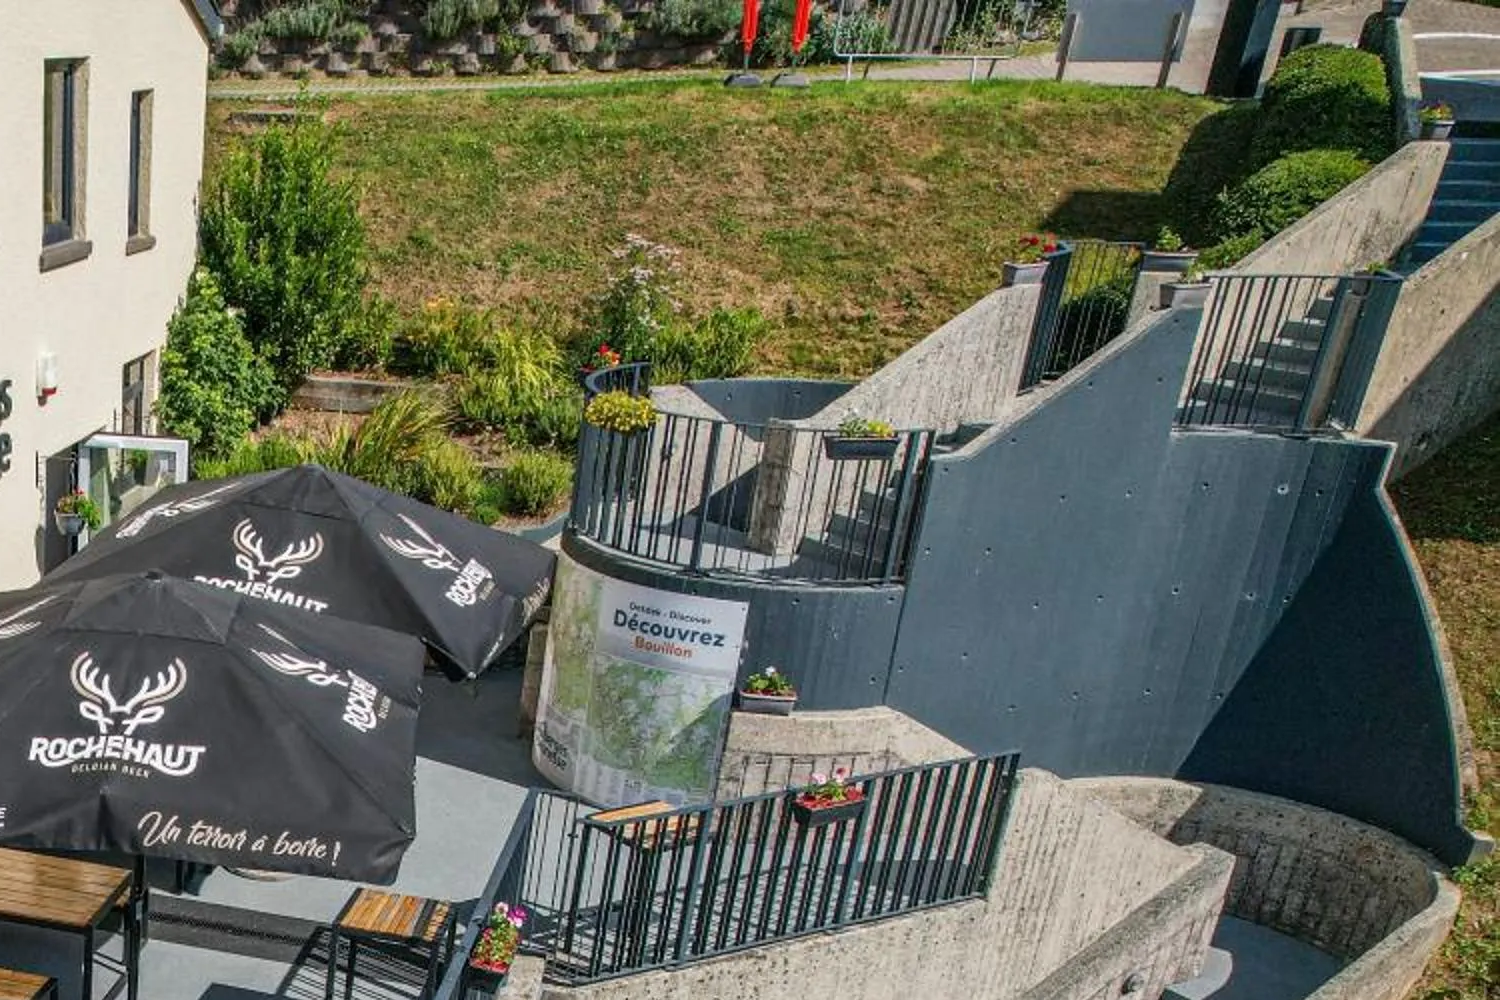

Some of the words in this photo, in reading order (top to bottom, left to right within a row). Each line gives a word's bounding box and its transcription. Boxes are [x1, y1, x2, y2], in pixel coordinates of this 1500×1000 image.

[613, 608, 725, 647] Découvrez
[635, 635, 692, 657] Bouillon
[27, 735, 207, 777] ROCHEHAUT
[137, 811, 182, 847] Un
[272, 831, 327, 858] boire
